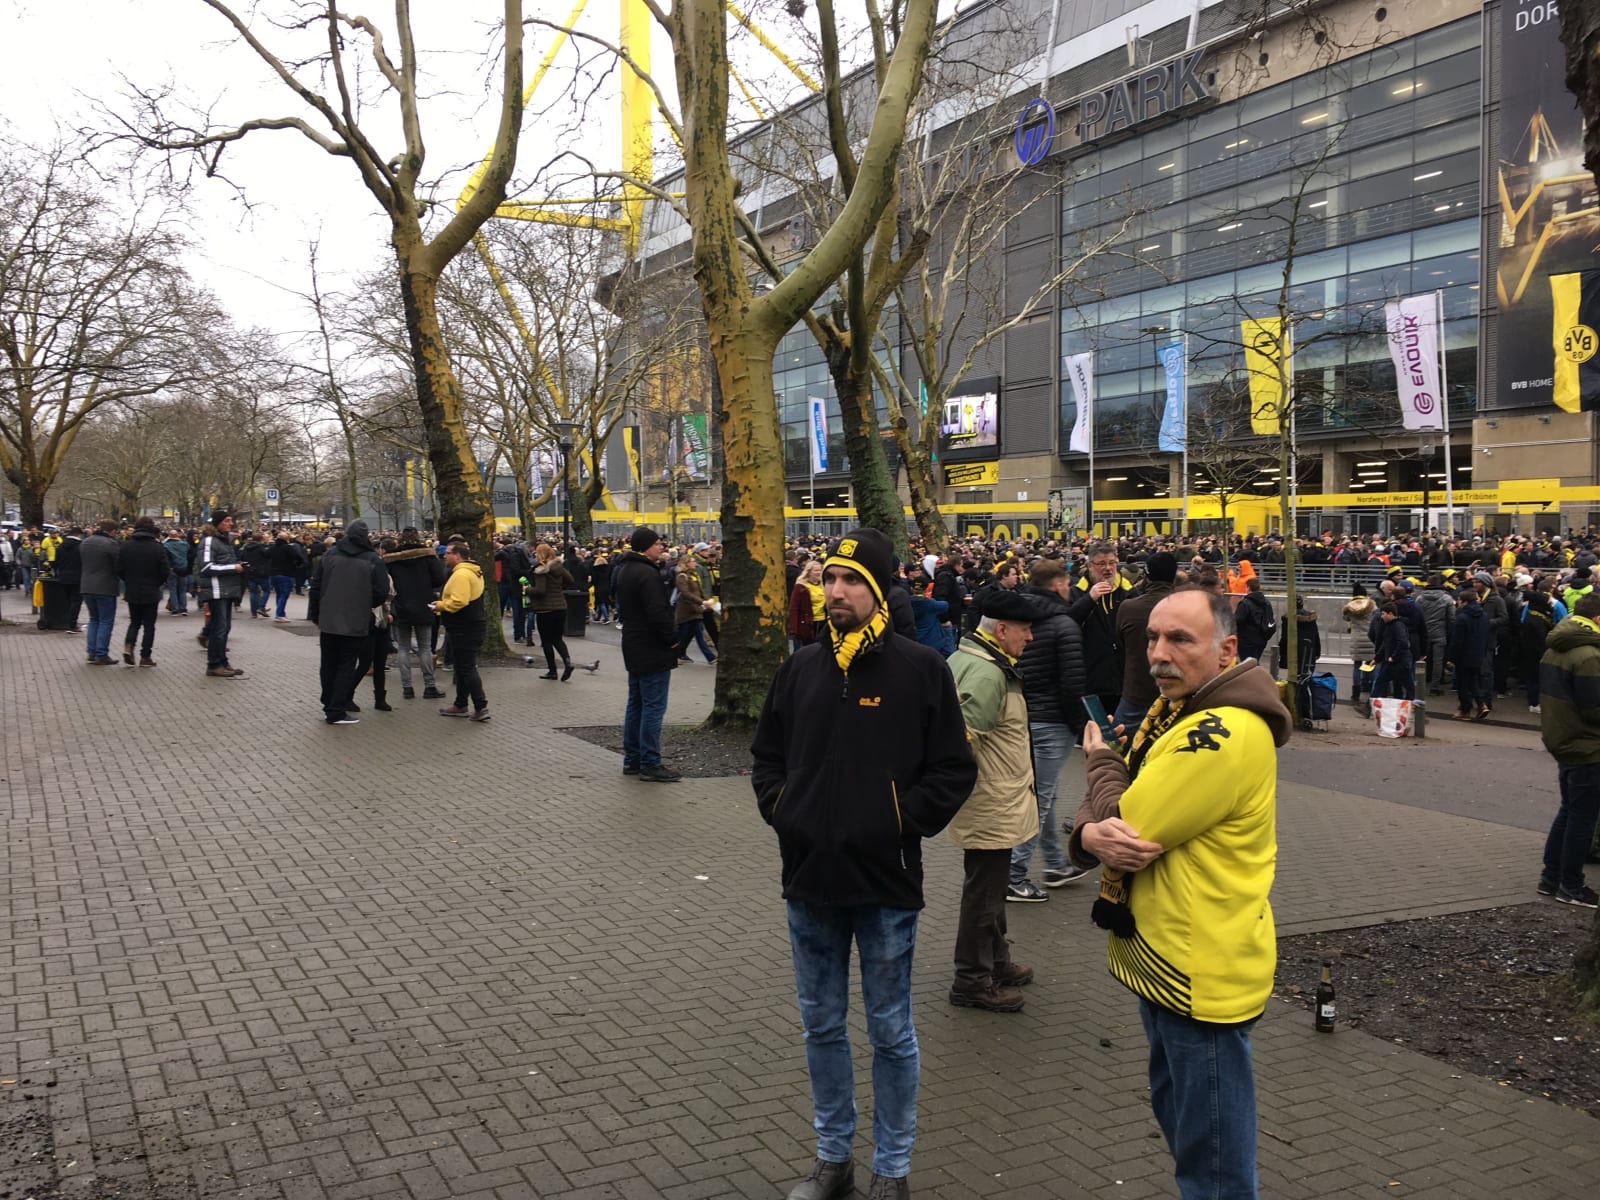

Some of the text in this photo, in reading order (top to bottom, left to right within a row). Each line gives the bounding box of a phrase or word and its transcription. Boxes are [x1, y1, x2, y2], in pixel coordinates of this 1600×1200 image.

[1080, 48, 1209, 143] PARK
[1511, 378, 1553, 389] BVB HOME
[1414, 494, 1444, 502] Süwest
